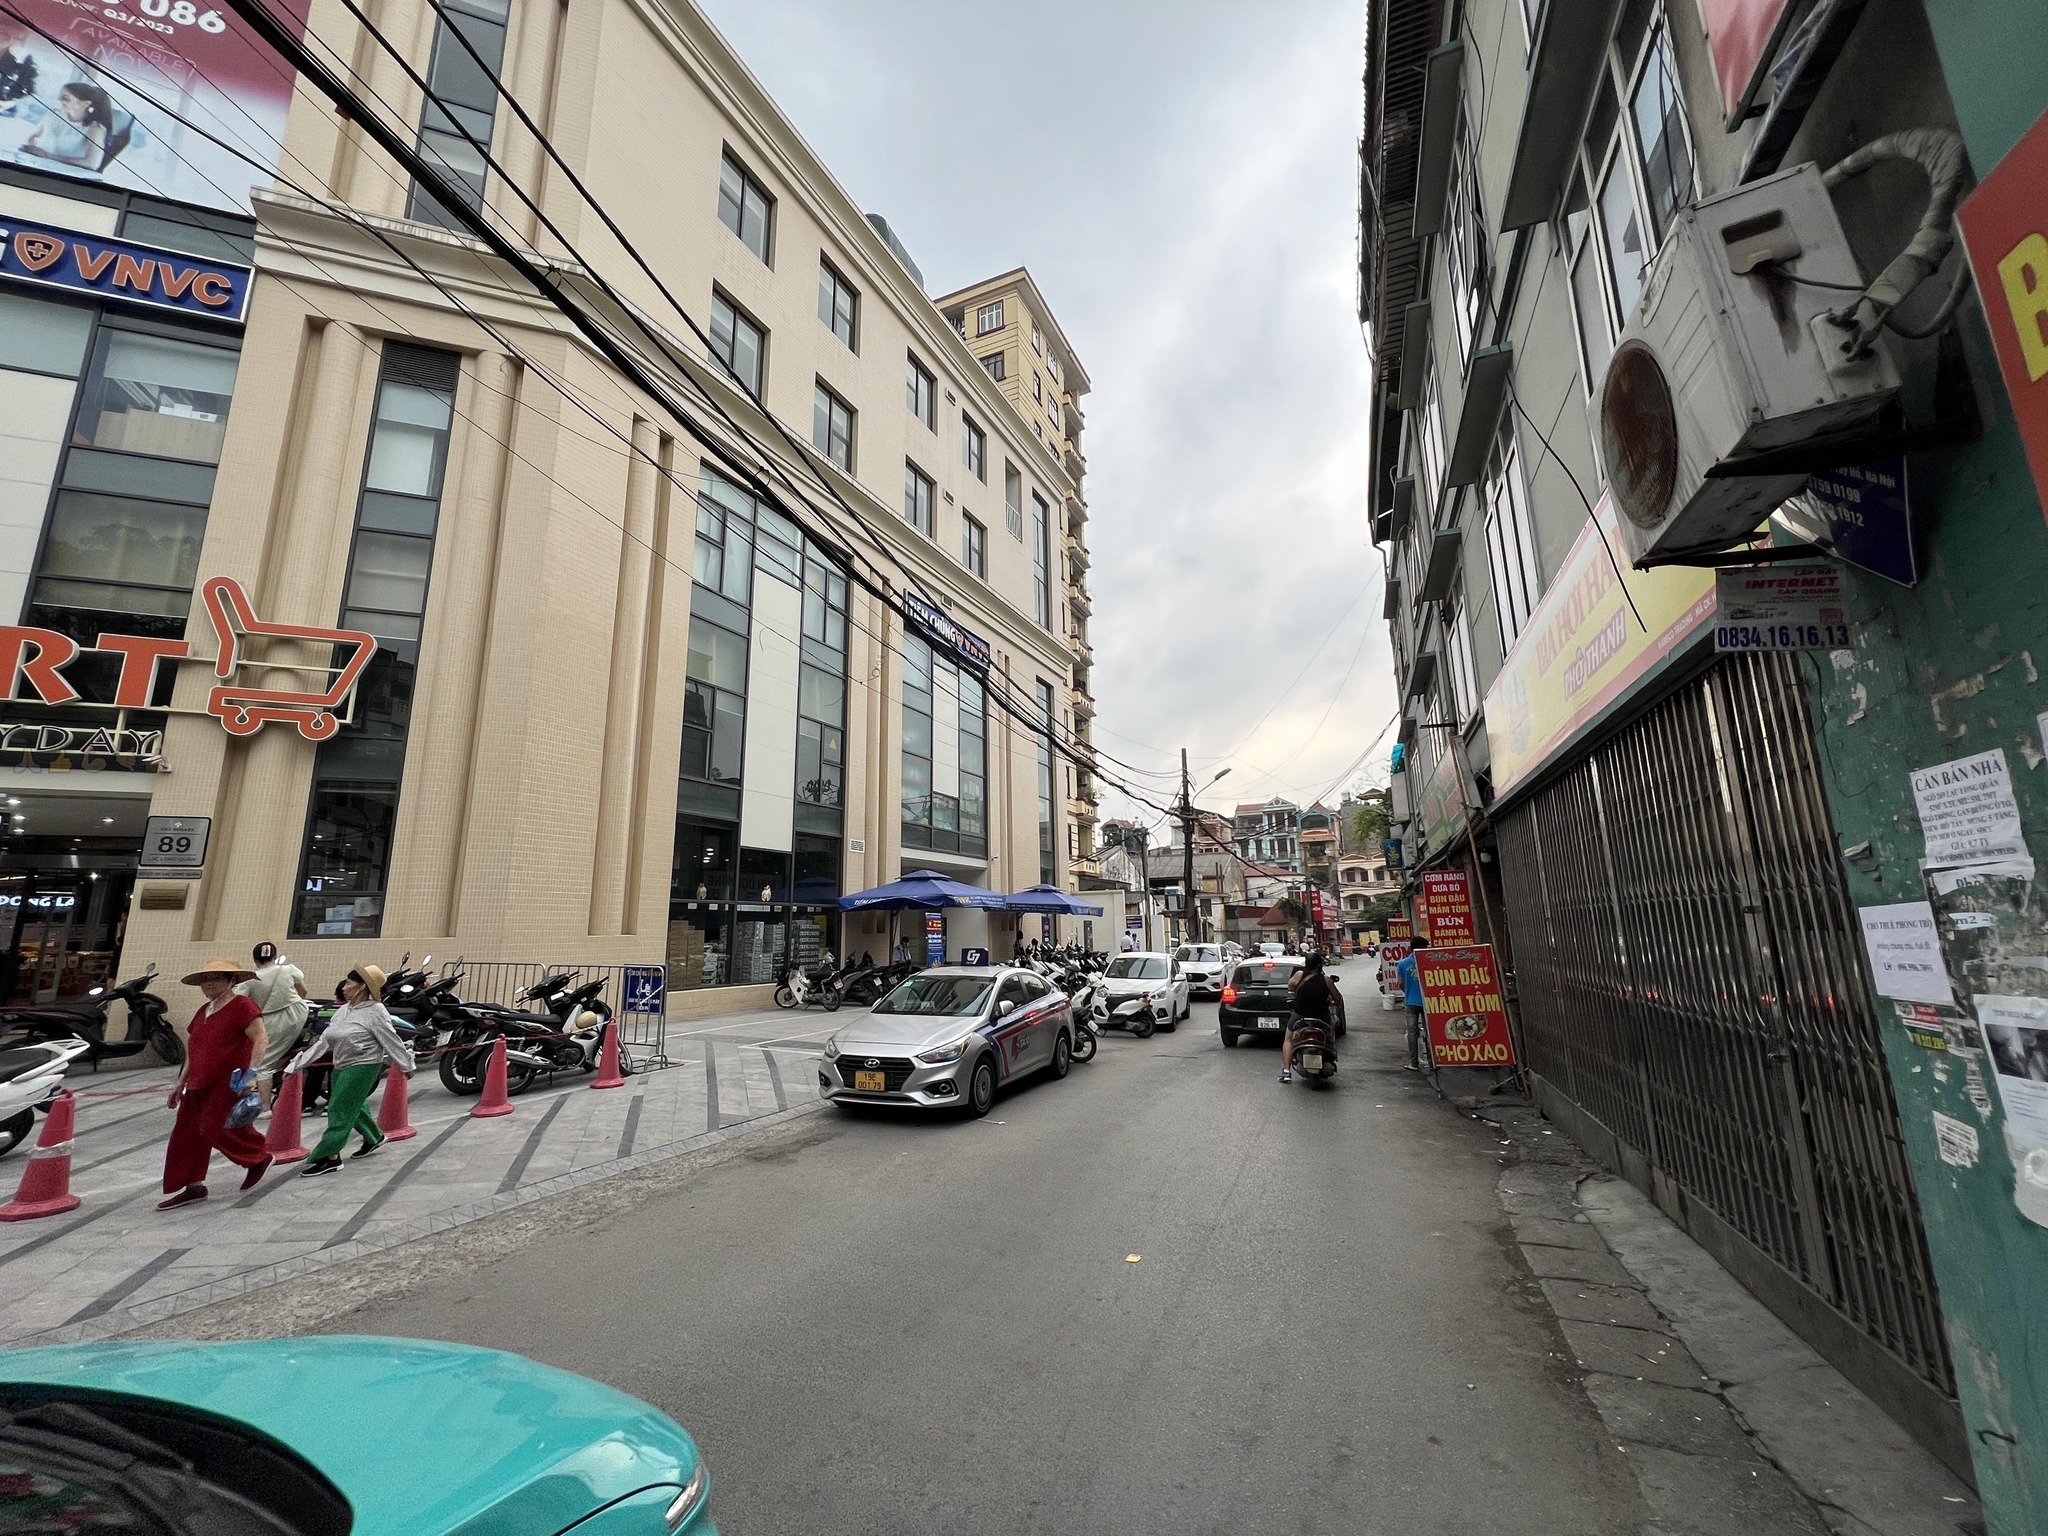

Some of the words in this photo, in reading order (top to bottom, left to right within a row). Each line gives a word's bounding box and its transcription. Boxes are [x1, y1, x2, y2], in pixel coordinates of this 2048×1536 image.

[103, 8, 175, 35] Q3/2023
[72, 244, 232, 305] VNVC
[1832, 482, 1861, 503] 0199
[1835, 506, 1865, 527] 1912
[1744, 576, 1839, 590] INTERNET
[1717, 624, 1850, 648] 0834.16.16.13
[1941, 764, 1969, 786] BÁN
[1970, 753, 2003, 778] NHÀ
[157, 836, 191, 853] 89
[1443, 872, 1465, 881] RANG
[1389, 923, 1411, 938] BÚN
[1436, 915, 1464, 926] BÚN
[966, 949, 981, 964] G7
[1424, 965, 1456, 987] BÚN
[1458, 963, 1491, 988] ĐẬU
[1424, 989, 1464, 1014] MẮM
[1465, 990, 1501, 1013] TÔM
[1434, 1040, 1470, 1062] PHỞ
[1470, 1040, 1508, 1061] XÀO
[864, 1072, 877, 1082] 19E
